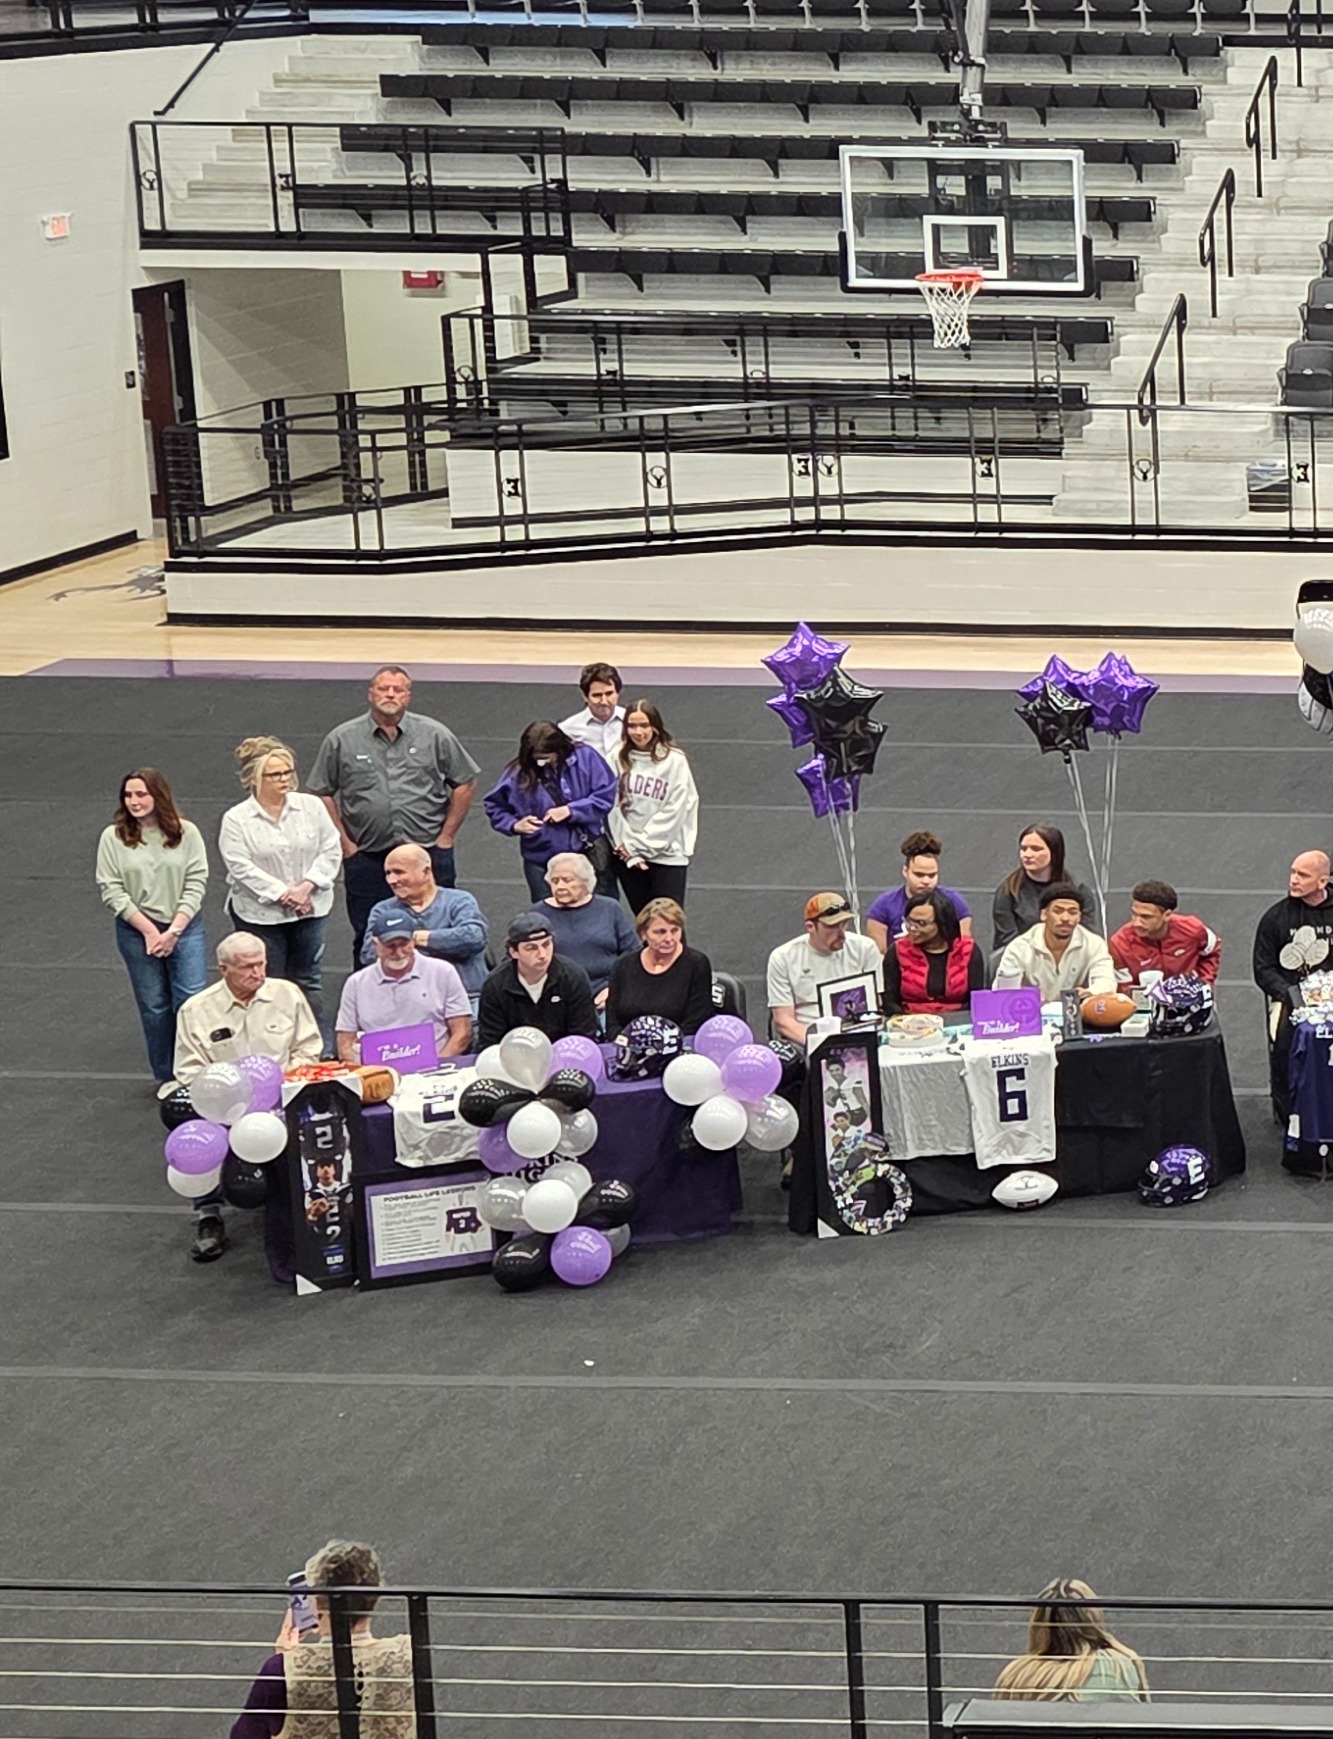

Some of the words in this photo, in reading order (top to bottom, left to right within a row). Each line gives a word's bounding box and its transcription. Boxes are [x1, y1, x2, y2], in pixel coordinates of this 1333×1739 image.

[627, 772, 668, 800] LDERS
[991, 1053, 1030, 1068] ELKINS
[997, 1068, 1028, 1122] 6
